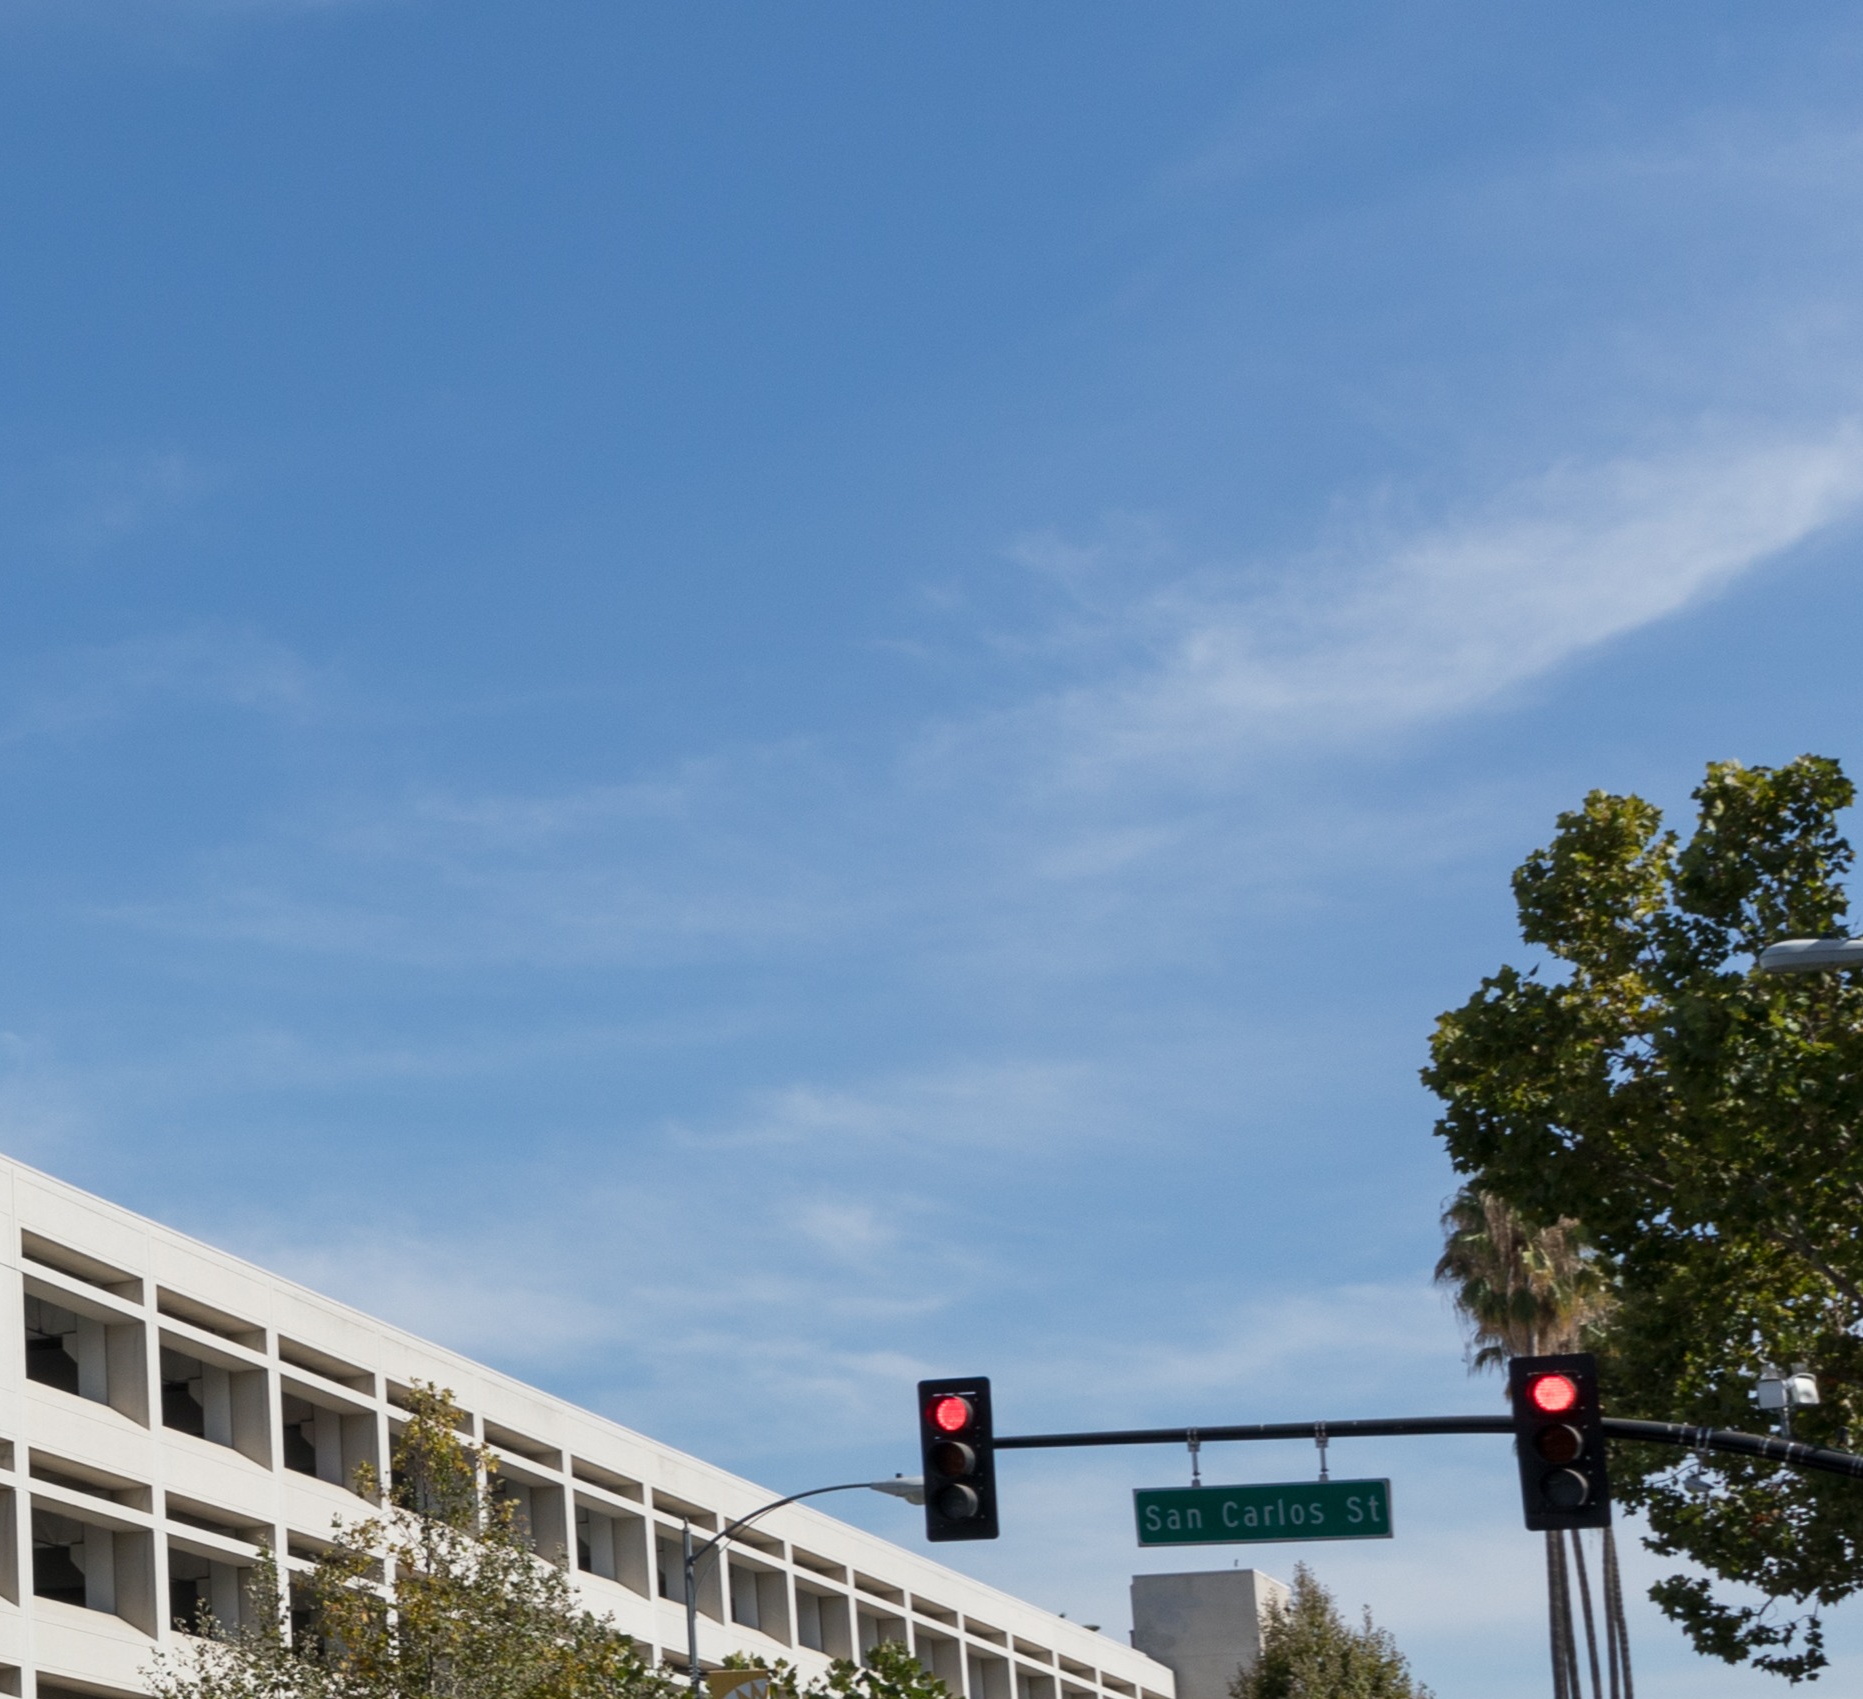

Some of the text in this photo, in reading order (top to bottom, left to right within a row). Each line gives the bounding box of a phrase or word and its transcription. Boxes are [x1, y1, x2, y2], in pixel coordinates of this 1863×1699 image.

[1145, 1496, 1381, 1531] San Carlos St
